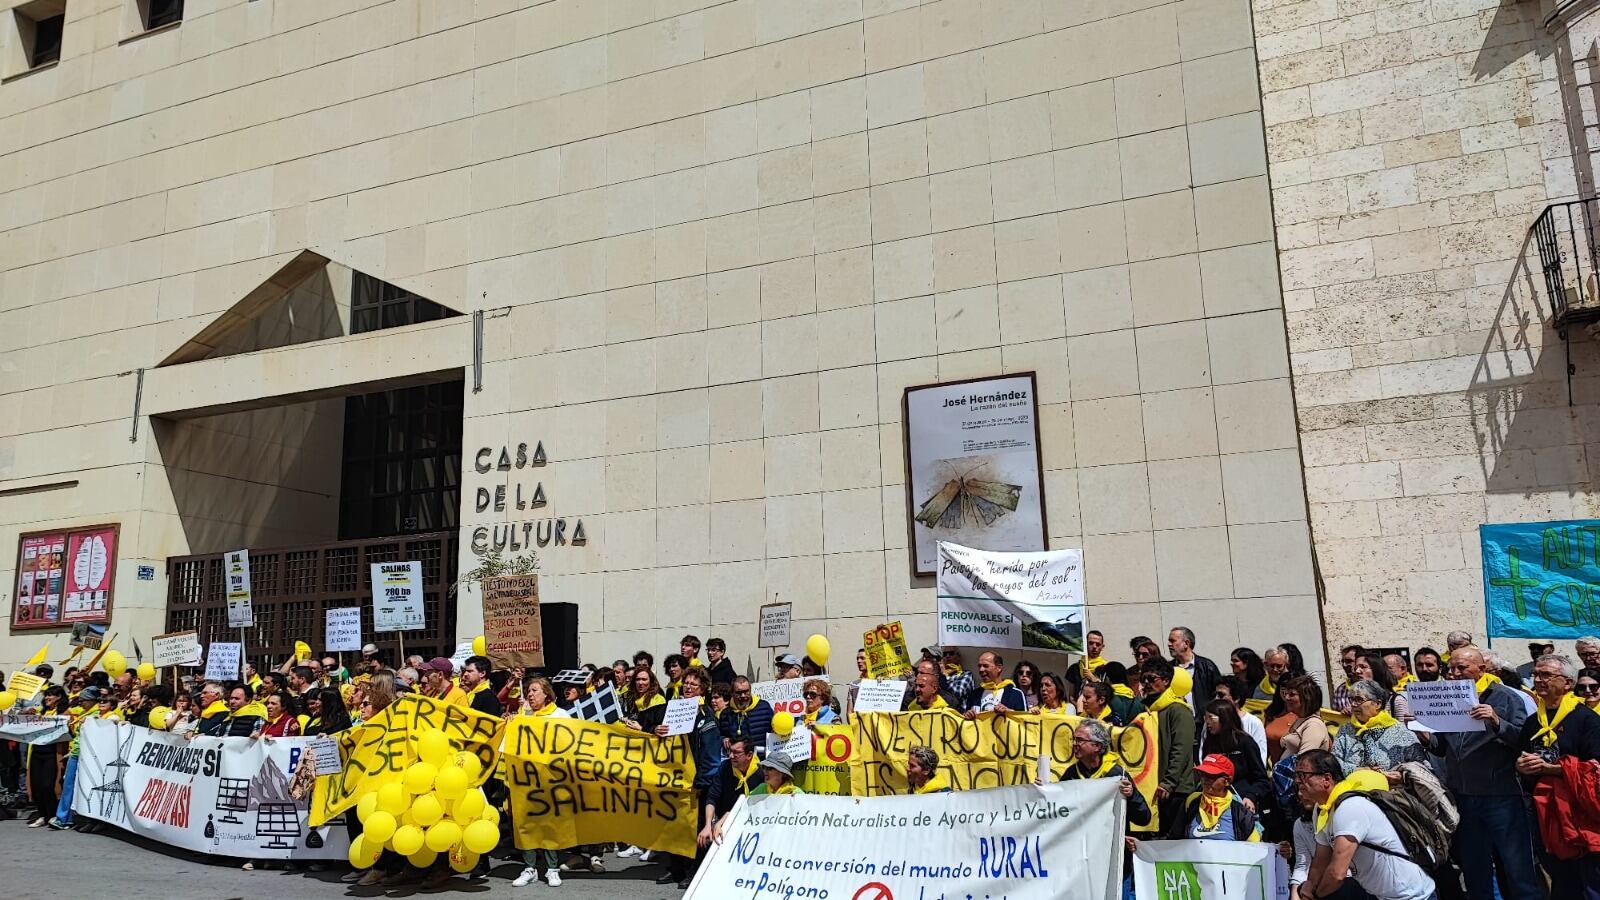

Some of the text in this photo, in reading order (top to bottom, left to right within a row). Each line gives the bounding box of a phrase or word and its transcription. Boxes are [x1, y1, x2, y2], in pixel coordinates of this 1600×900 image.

[942, 390, 1027, 408] José Hernández
[475, 440, 547, 474] CASA
[476, 482, 547, 513] DE LA
[471, 519, 587, 556] CULTURA
[381, 564, 411, 573] SALINAS
[1028, 559, 1049, 577] por
[385, 587, 411, 596] 280 ha
[972, 576, 988, 591] los
[1029, 571, 1049, 588] del
[518, 616, 529, 626] DE
[941, 611, 1014, 623] RENOVABLES SÍ
[865, 623, 899, 646] STOP
[946, 623, 1010, 635] PERÒ NO AIXÍ
[774, 700, 805, 714] NO
[855, 711, 980, 756] NUESTRO
[991, 713, 1076, 764] SUELO
[135, 741, 225, 777] RENOVABLES SÍ
[512, 757, 685, 788] LA SIERRA DE
[134, 776, 194, 829] PERO NO ASÍ
[526, 784, 679, 821] SALINAS
[744, 801, 1071, 830] Asociación Naturalista de Ayora y La Valle
[728, 831, 1049, 879] NO a la conversión del mundo RURAL
[735, 877, 756, 890] en
